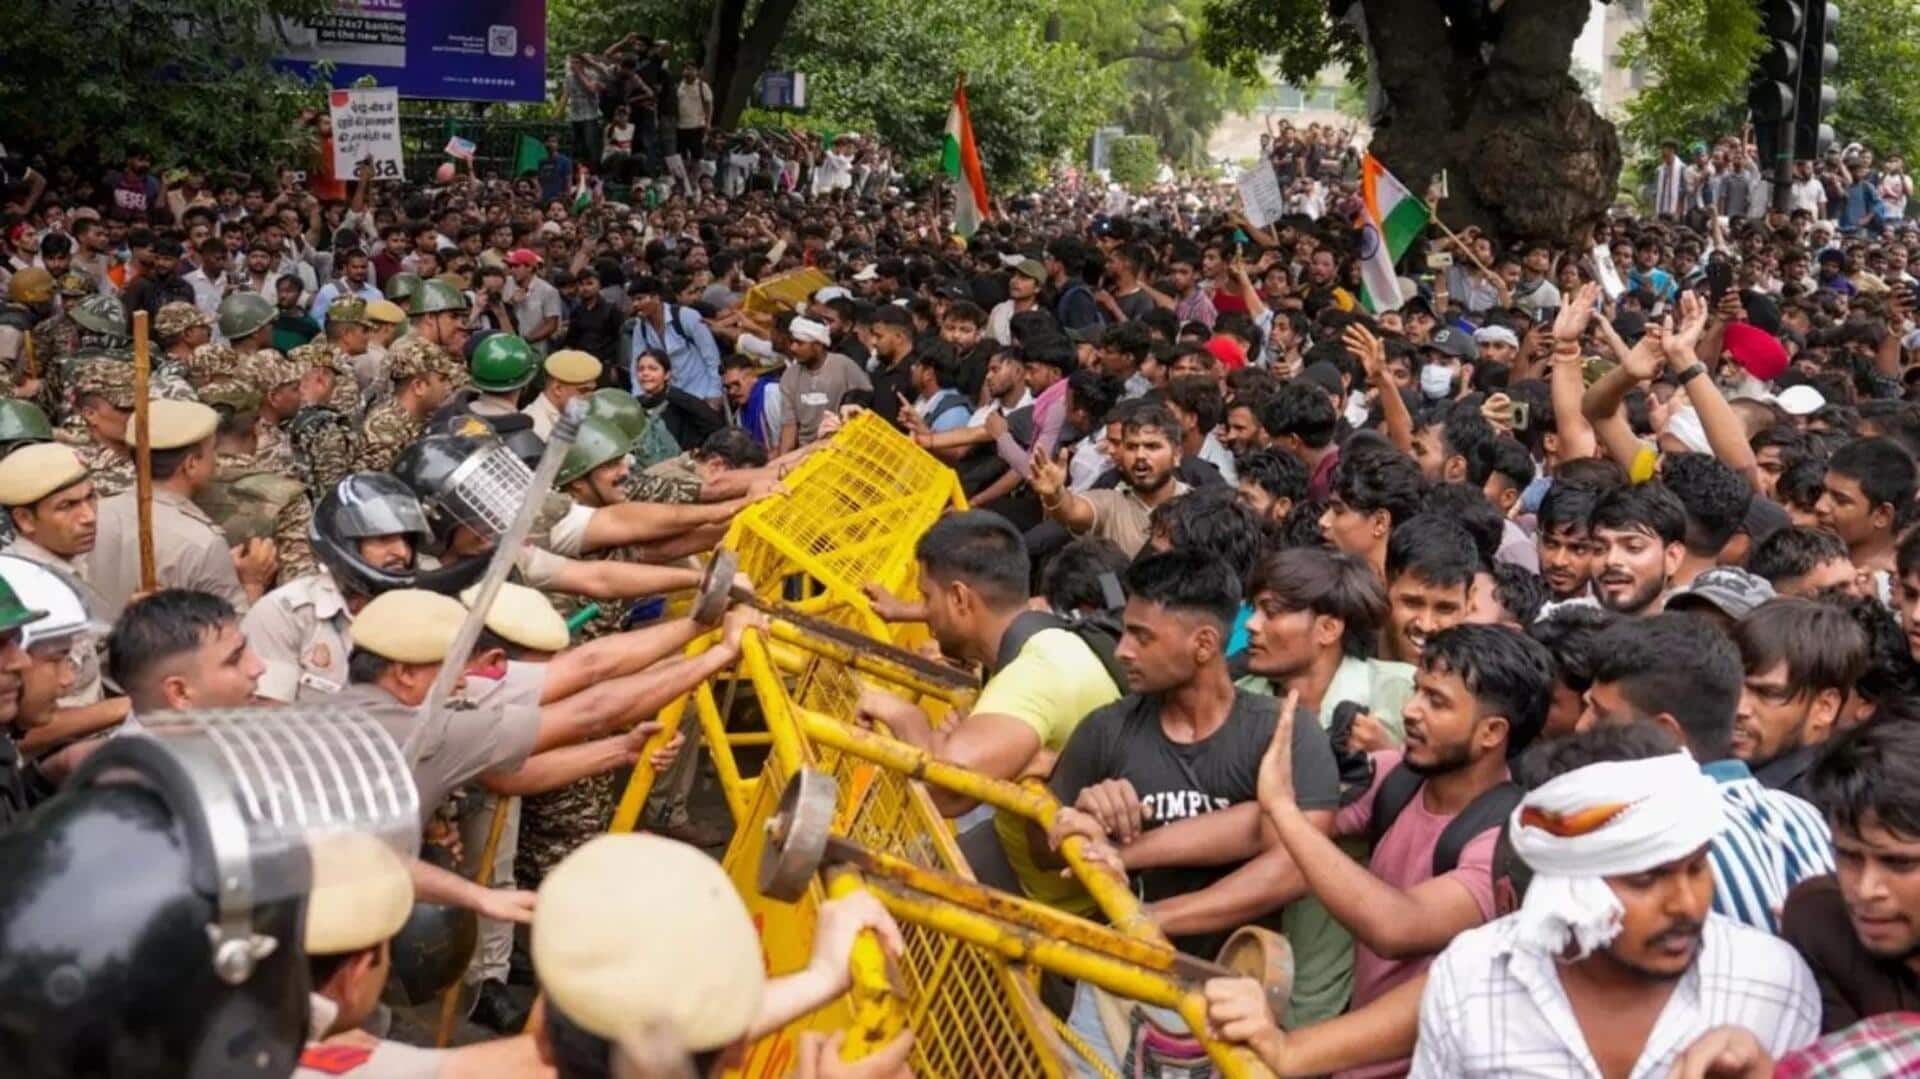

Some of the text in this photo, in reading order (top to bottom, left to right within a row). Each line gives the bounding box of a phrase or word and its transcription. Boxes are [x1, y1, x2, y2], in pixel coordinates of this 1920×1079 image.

[338, 18, 363, 29] 24x7
[365, 20, 407, 34] banking
[321, 30, 336, 38] on
[337, 29, 355, 39] the
[357, 32, 379, 41] new
[353, 158, 399, 177] asa
